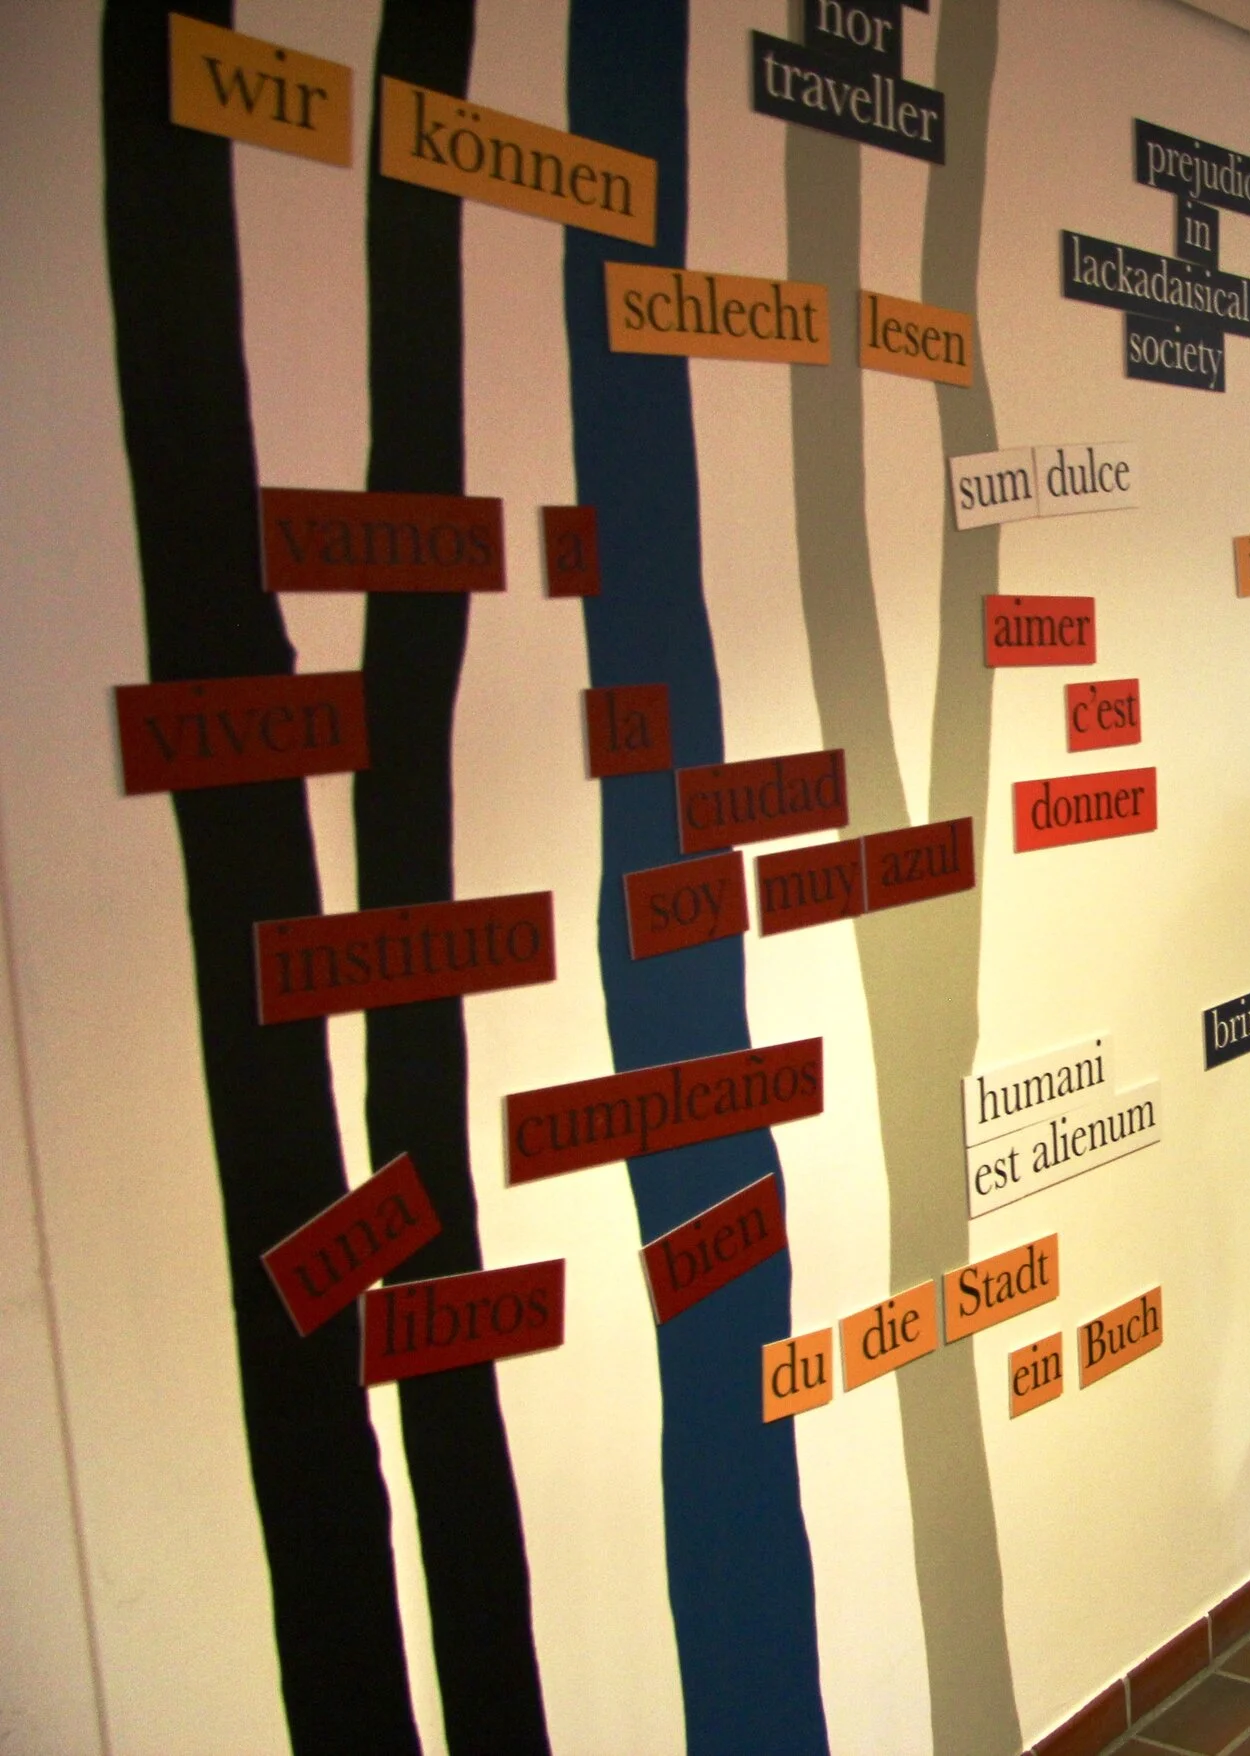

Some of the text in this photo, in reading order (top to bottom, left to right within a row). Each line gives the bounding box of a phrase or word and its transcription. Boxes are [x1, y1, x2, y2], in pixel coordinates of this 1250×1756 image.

[202, 49, 636, 217] wir können
[763, 51, 938, 143] traveller
[1186, 203, 1211, 252] in
[623, 271, 966, 366] schlecht lesen
[1072, 236, 1250, 322] lackadaisical
[1129, 326, 1222, 389] society
[959, 447, 1130, 509] sum dulce
[277, 518, 585, 572] vamos a
[994, 597, 1090, 647] aimer
[145, 685, 343, 765] viven
[604, 691, 652, 755] la
[685, 752, 842, 832] ciudad
[1031, 781, 1145, 830] donner
[650, 823, 962, 934] soy muy azul
[275, 910, 542, 997] instituto
[515, 1055, 818, 1158] cumpleaños
[977, 1039, 1105, 1125] humani
[974, 1100, 1156, 1197] est alienum
[291, 1195, 419, 1299] una
[660, 1200, 769, 1293] bien
[383, 1282, 549, 1358] libros
[770, 1246, 1050, 1399] du die Stadt
[1012, 1297, 1159, 1399] ein Buch
